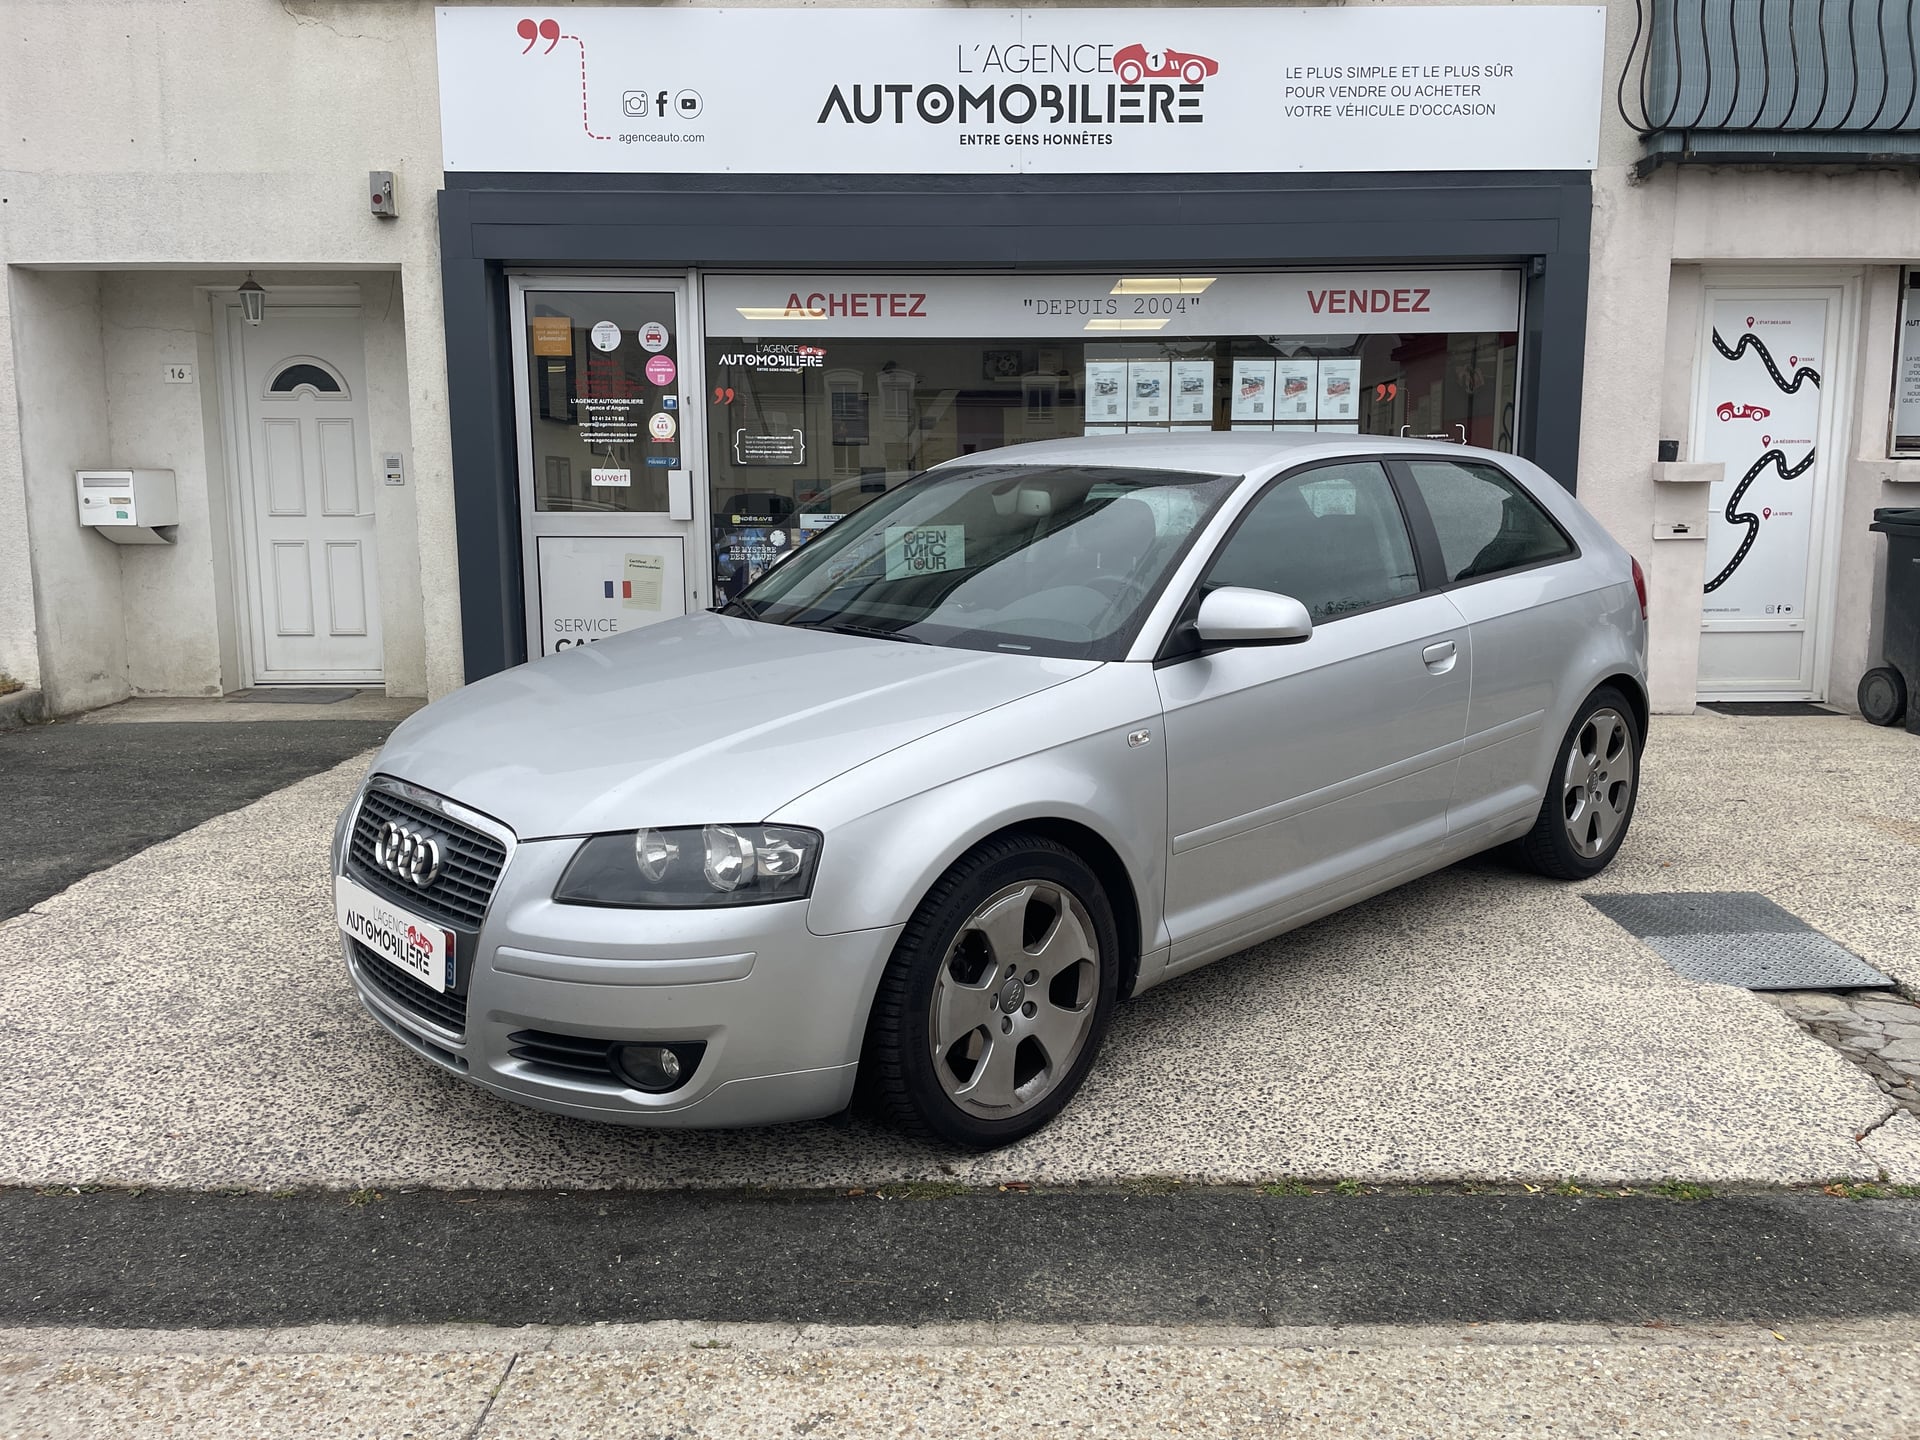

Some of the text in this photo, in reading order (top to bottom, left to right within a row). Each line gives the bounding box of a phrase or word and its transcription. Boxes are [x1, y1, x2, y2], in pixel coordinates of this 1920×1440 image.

[958, 43, 1114, 74] L'AGENCE
[1285, 62, 1514, 79] LE PLUS SIMPLE ET LE PLUS SÛR
[1285, 84, 1481, 98] POUR VENDRE OU ACHETER
[1285, 102, 1496, 117] VOTRE VÉHICULE D'OCCASION
[618, 132, 705, 145] agenceauto.com
[959, 131, 1113, 146] ENTRE GENS HONNÊTES
[783, 292, 927, 318] ACHETEZ
[1307, 289, 1431, 314] VENDEZ
[756, 344, 799, 354] L'AGENCE
[170, 368, 185, 379] 16
[594, 473, 627, 482] ouvert
[903, 530, 947, 545] OPEN
[903, 543, 946, 558] MIC
[903, 557, 947, 571] TOUR
[554, 618, 618, 632] SERVICE
